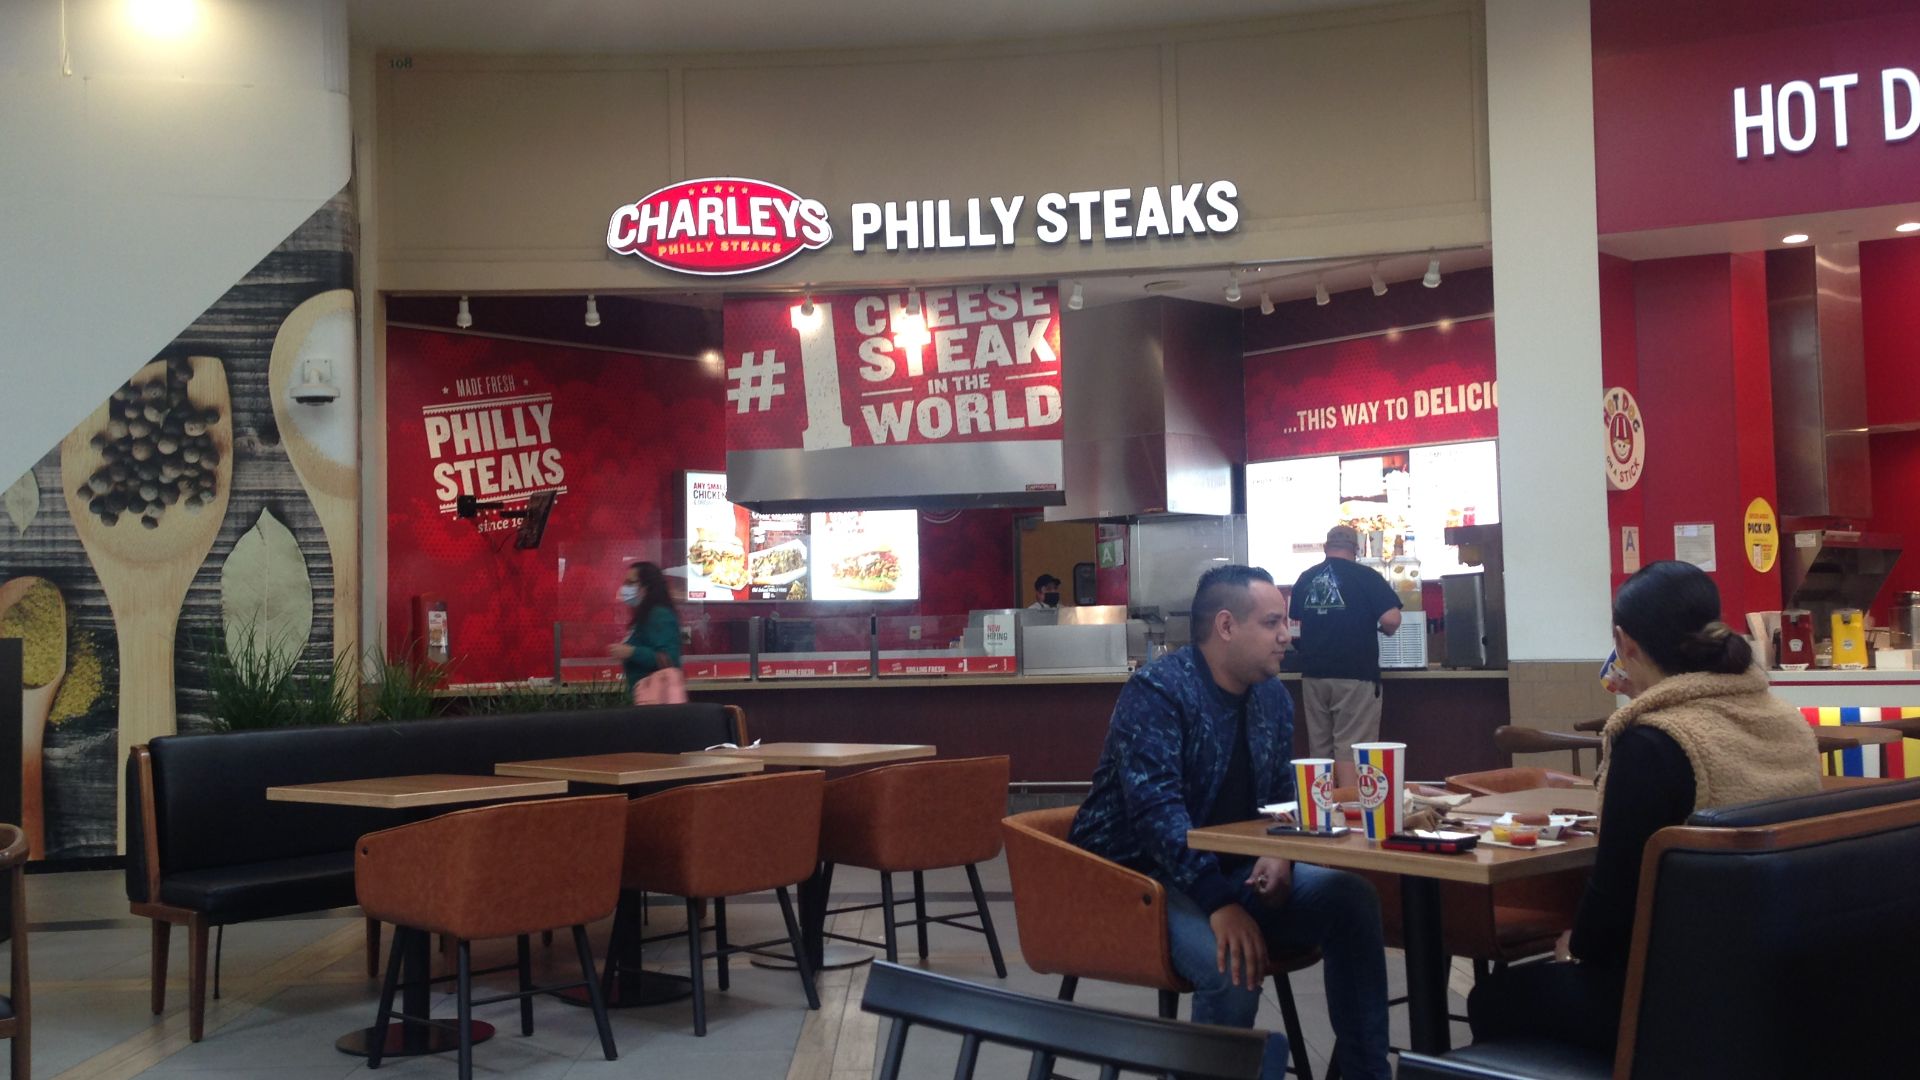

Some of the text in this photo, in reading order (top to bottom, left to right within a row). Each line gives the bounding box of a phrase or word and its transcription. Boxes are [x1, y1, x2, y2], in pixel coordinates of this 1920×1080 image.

[1733, 73, 1858, 159] HOT
[608, 196, 831, 249] CHARLEYS
[851, 180, 1239, 252] PHILLY STEAKS
[658, 239, 782, 257] PHILLY STEAKS
[854, 282, 1052, 337] CHEESE
[858, 318, 1058, 383] STEAK
[456, 375, 516, 398] MADE FRESH
[928, 372, 991, 395] IN THE
[860, 385, 1063, 445] WORLD
[1341, 400, 1380, 427] WAY
[1384, 397, 1409, 421] TO
[1622, 392, 1640, 433] DOG
[424, 403, 553, 459] PHILLY
[433, 448, 565, 502] STEAKS
[1620, 457, 1640, 482] STICK
[478, 519, 509, 533] since
[1747, 523, 1772, 534] PICK UP
[1626, 530, 1636, 551] A
[1102, 547, 1113, 563] A
[987, 624, 1001, 633] NOW
[987, 632, 1008, 641] HIRING
